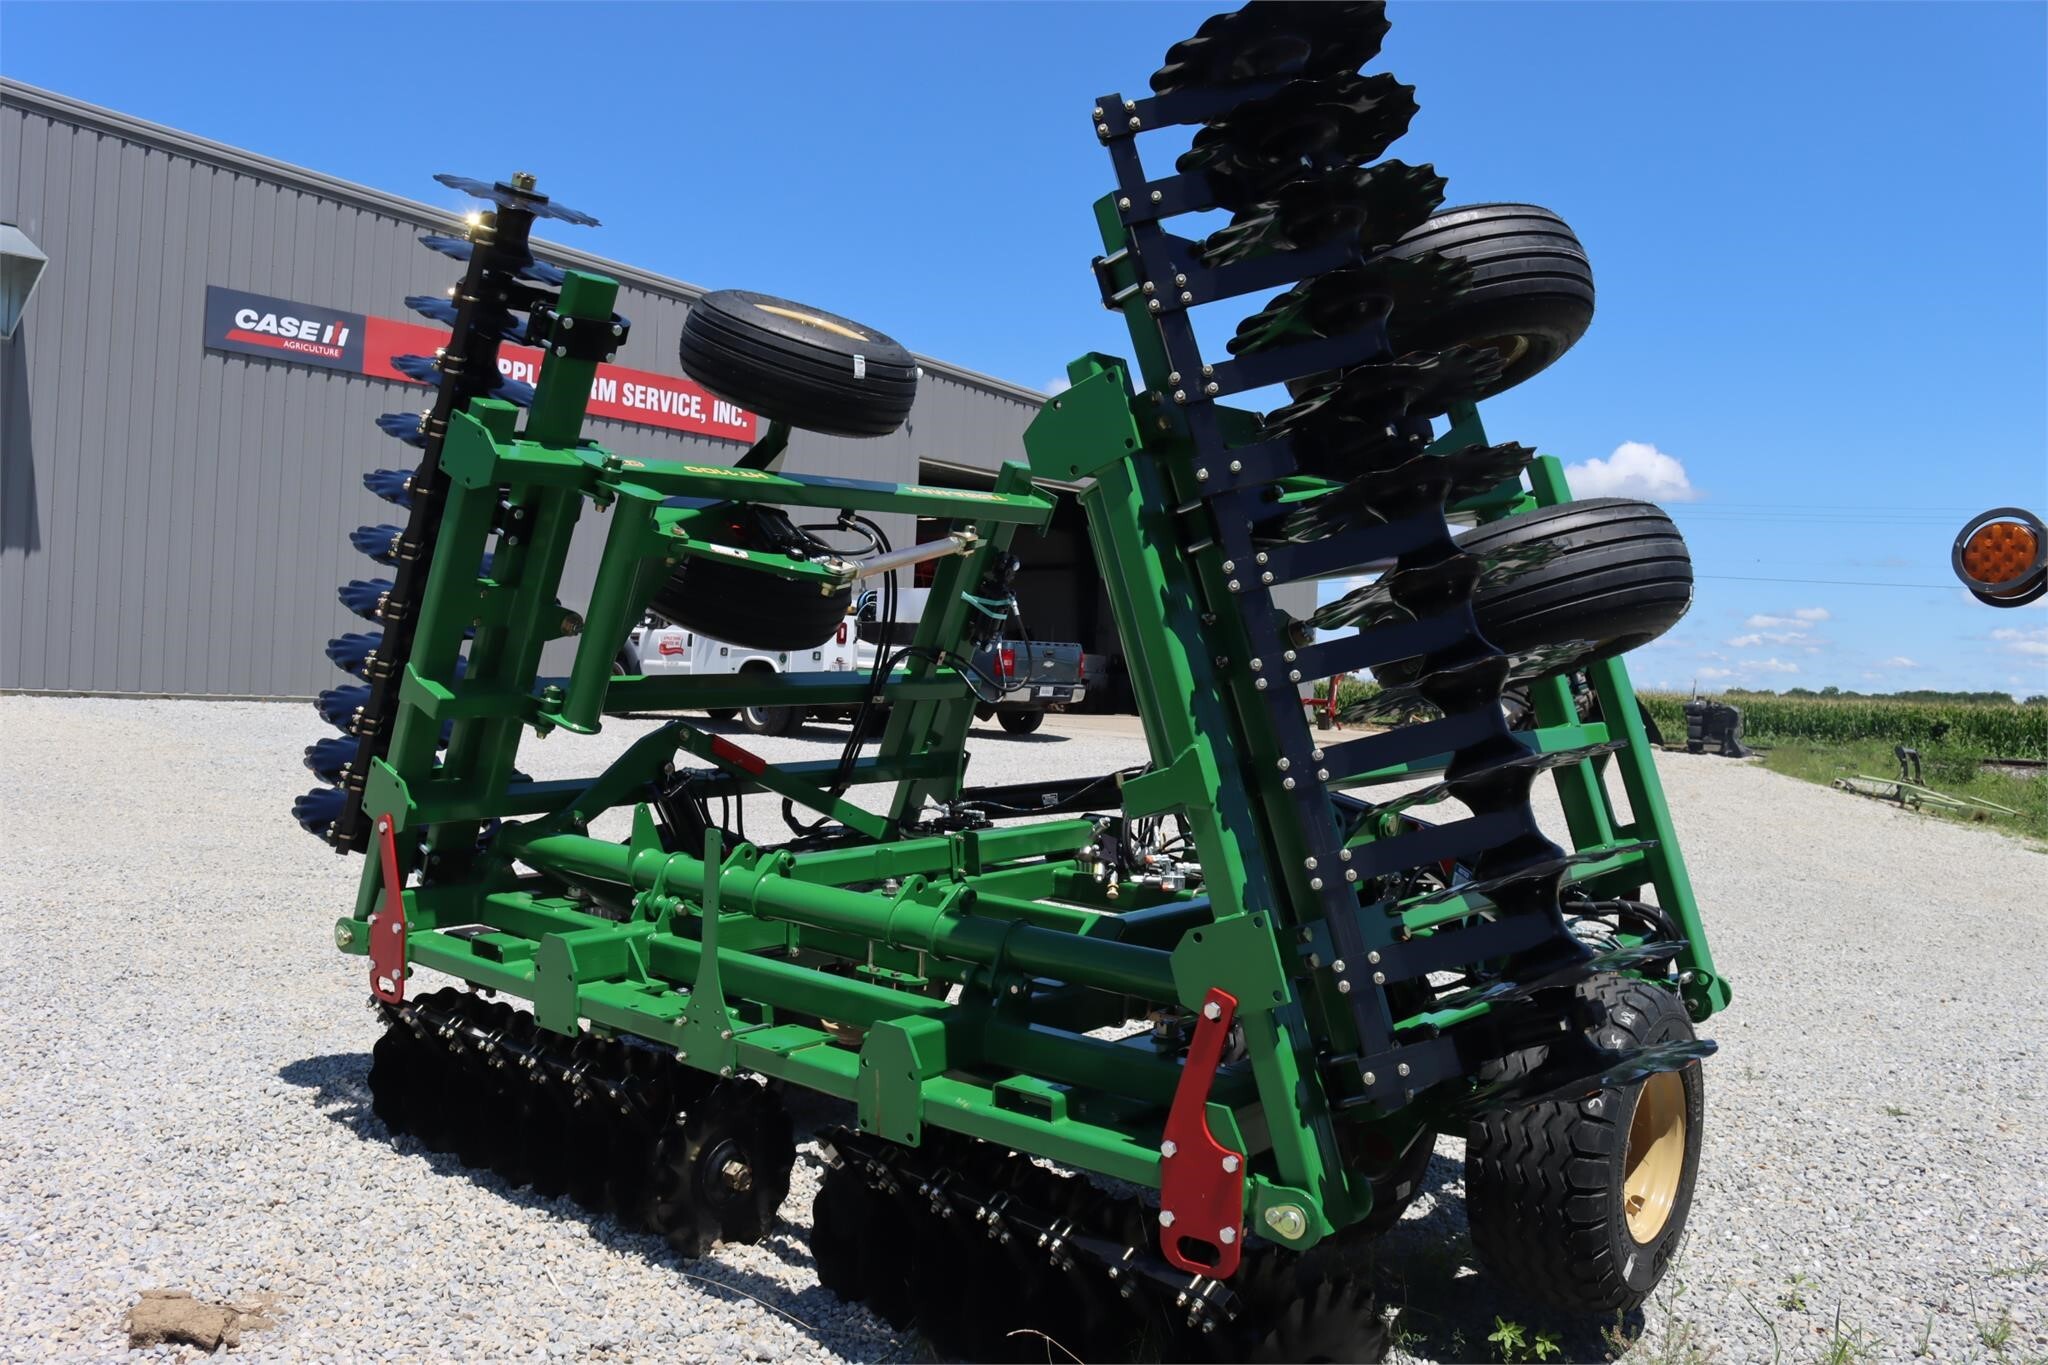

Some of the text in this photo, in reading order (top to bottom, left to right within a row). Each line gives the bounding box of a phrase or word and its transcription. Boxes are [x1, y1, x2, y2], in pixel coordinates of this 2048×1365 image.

[235, 308, 321, 342] CASE
[283, 340, 340, 358] AGRICULTURE
[622, 382, 707, 424] SERVICE,
[713, 399, 748, 428] INC.
